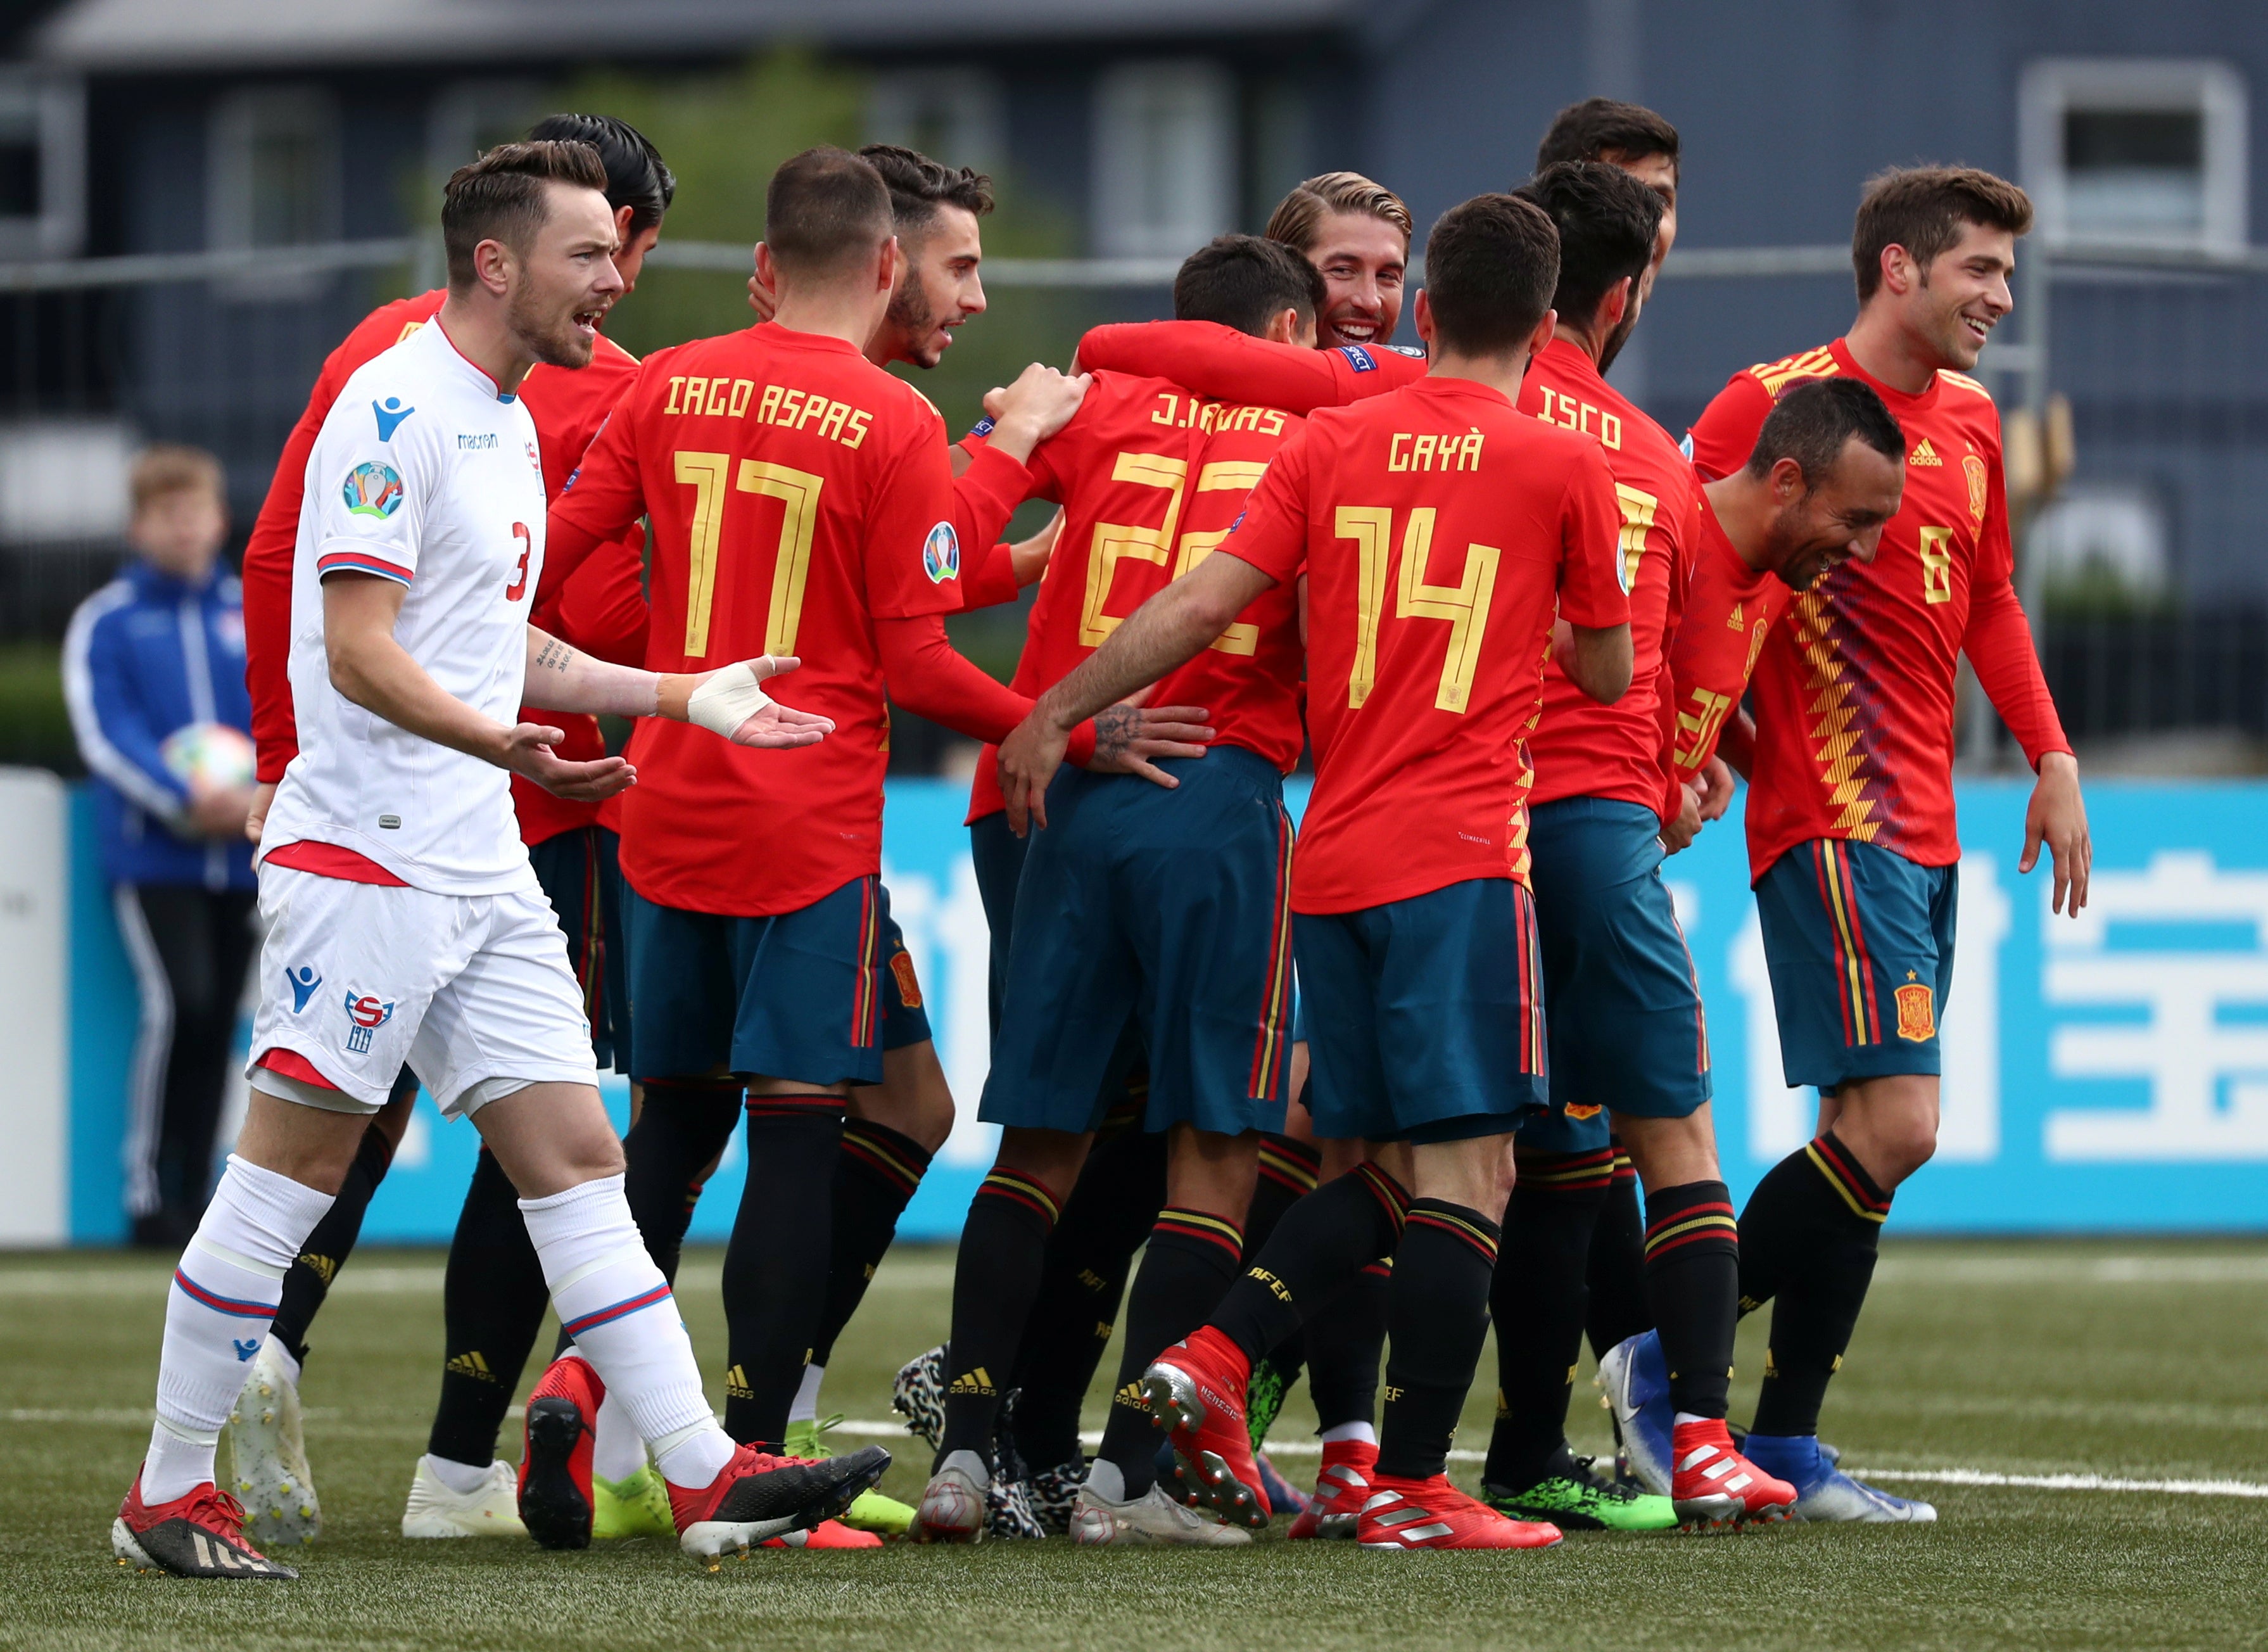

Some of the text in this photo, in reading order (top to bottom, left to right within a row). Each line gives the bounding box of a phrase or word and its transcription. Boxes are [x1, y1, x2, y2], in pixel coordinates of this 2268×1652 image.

[457, 433, 498, 450] macron
[664, 376, 873, 450] IAGO ASPAS
[1536, 384, 1621, 452] ISCO
[1388, 426, 1485, 472] GAYÀ
[1909, 454, 1943, 467] adidas
[505, 521, 531, 602] 3
[674, 450, 825, 658] 17
[1919, 525, 1953, 605] 8
[1334, 505, 1502, 715] 14
[1673, 687, 1732, 770] 20
[346, 1024, 373, 1052] 1979
[949, 1384, 998, 1397] adidas
